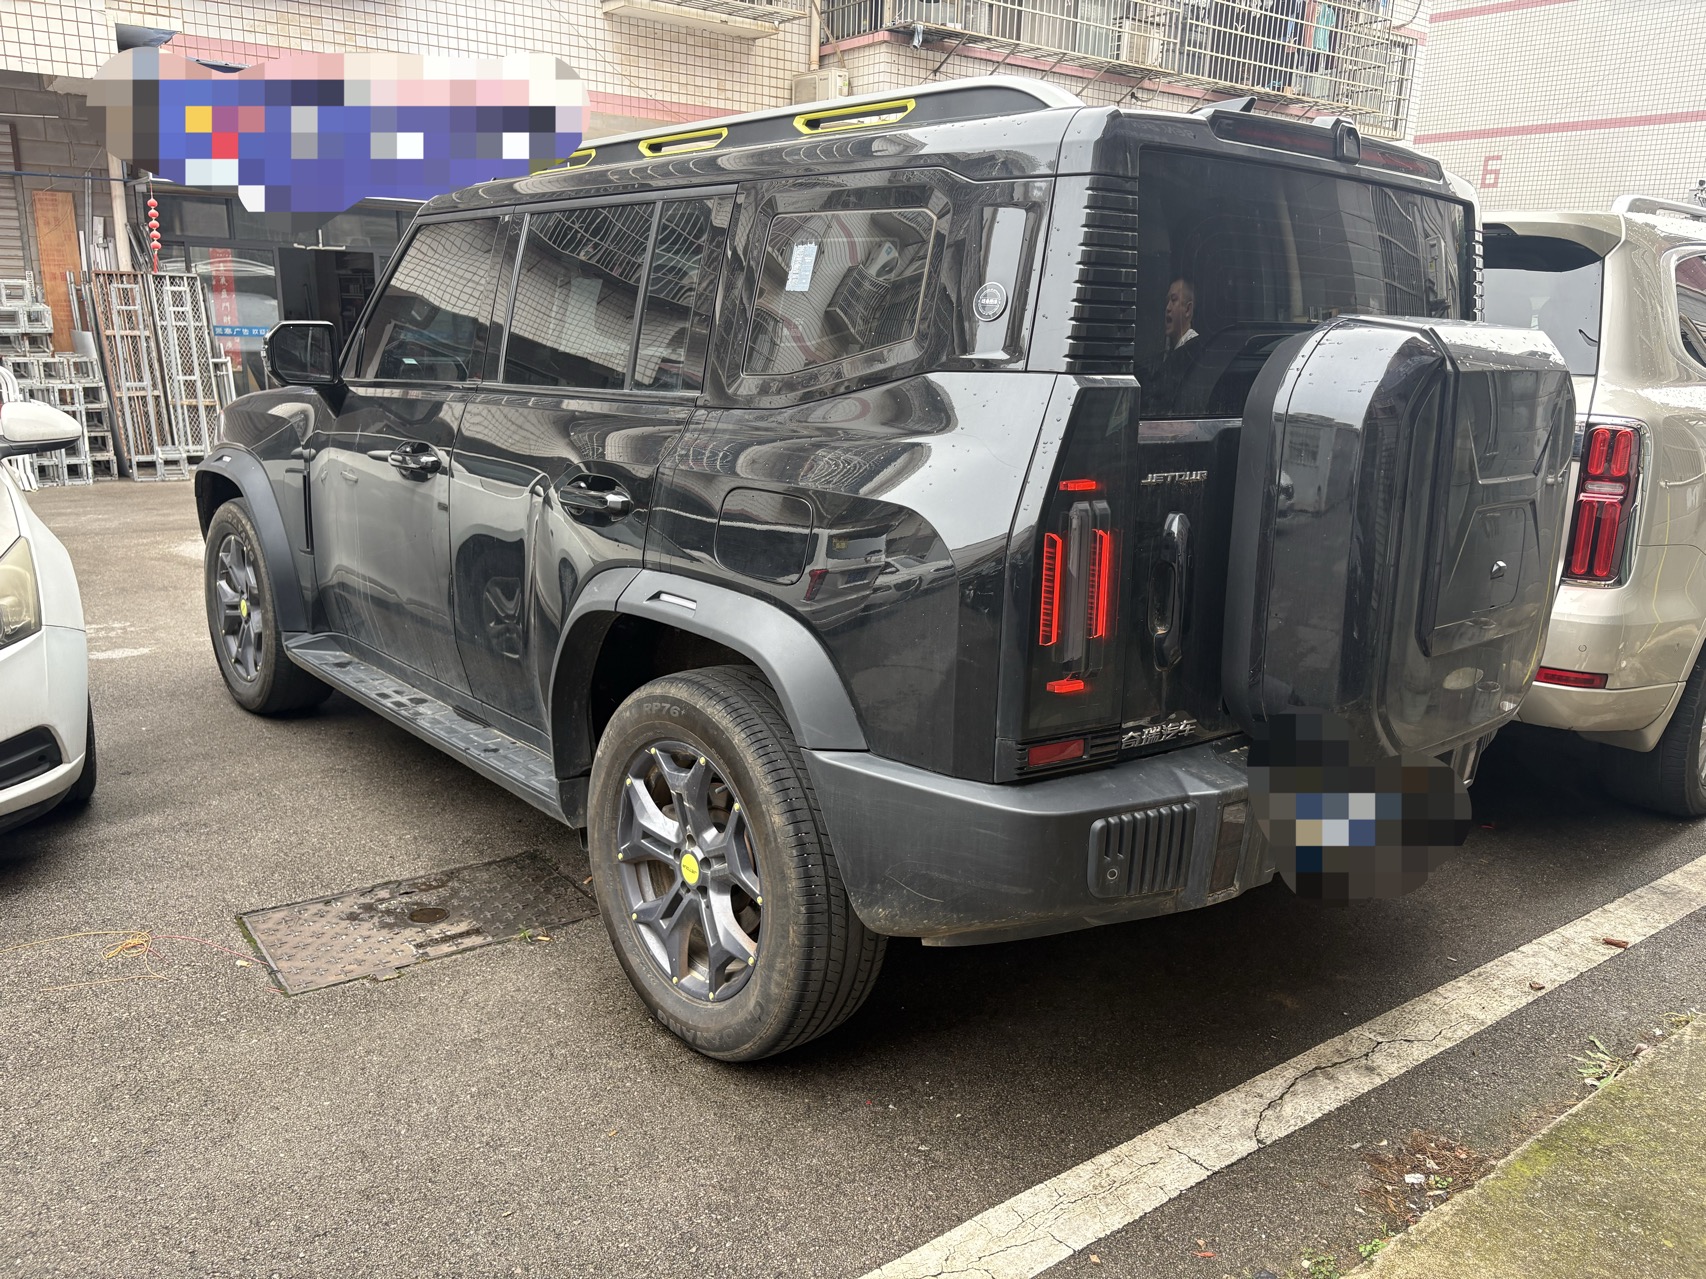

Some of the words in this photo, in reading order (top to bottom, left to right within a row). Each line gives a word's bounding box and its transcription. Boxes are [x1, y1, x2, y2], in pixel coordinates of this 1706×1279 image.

[1480, 155, 1502, 188] 6
[1141, 470, 1208, 484] JETOUR
[1121, 719, 1197, 749] 奇瑞汽车
